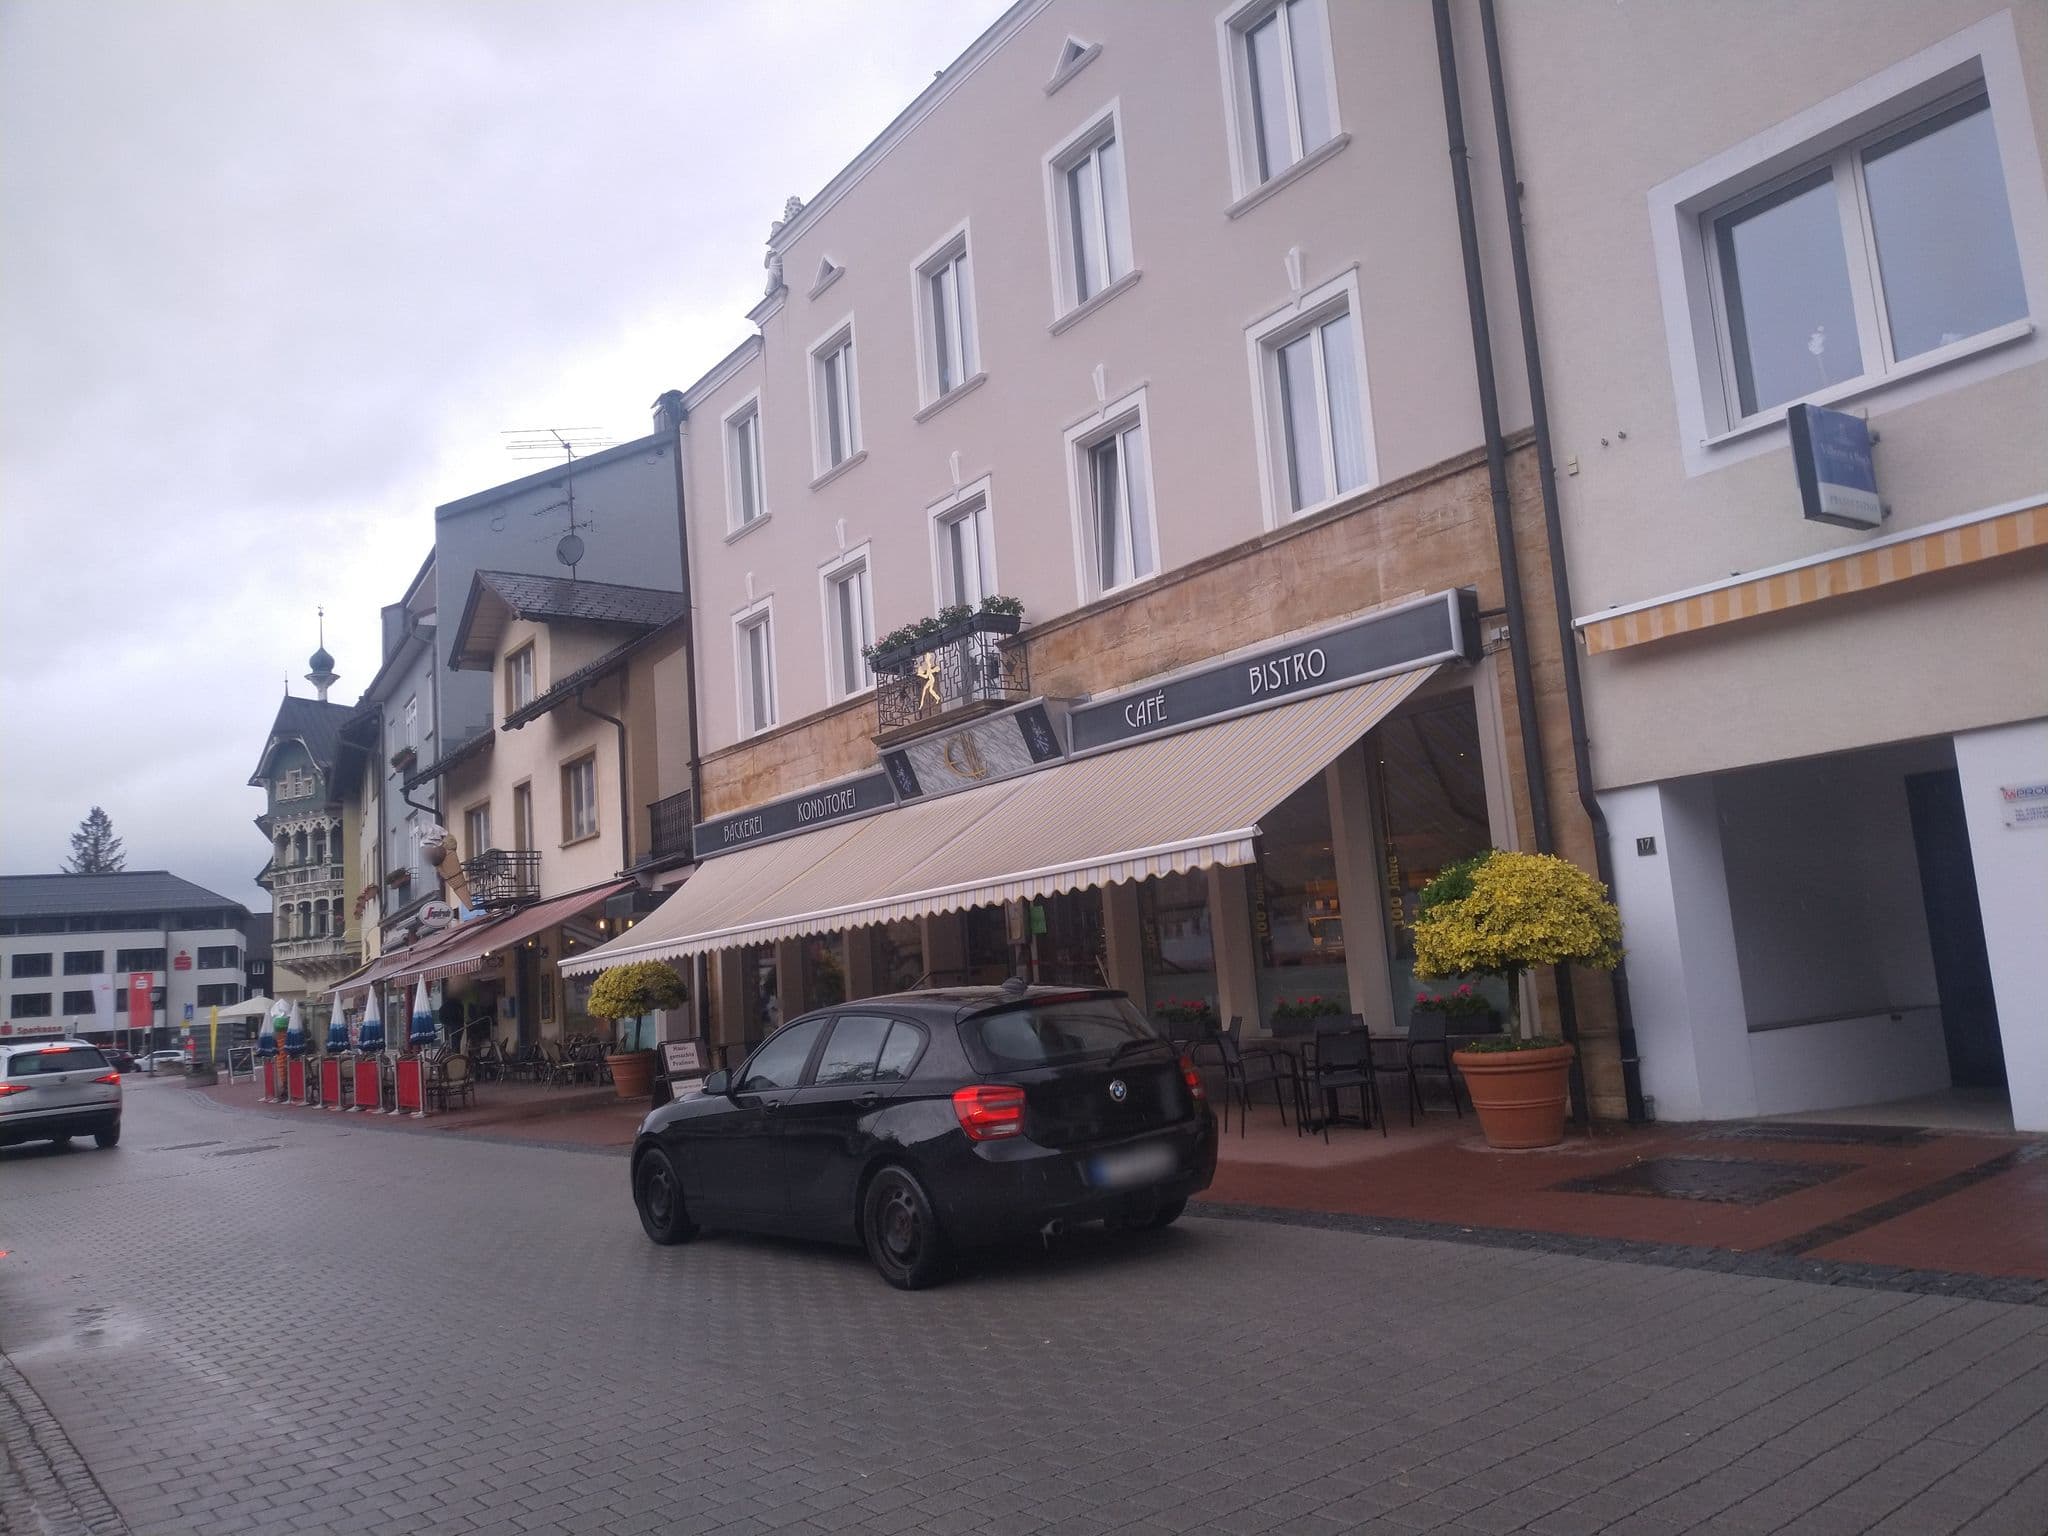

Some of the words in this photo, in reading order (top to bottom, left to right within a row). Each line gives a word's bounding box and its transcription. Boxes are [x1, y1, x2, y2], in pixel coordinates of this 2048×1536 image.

[1124, 690, 1168, 728] CAFÉ
[1249, 648, 1326, 695] BISTRO
[797, 788, 857, 822] KONDITOREI
[1640, 838, 1651, 849] 17
[17, 1025, 63, 1035] Sparkasse
